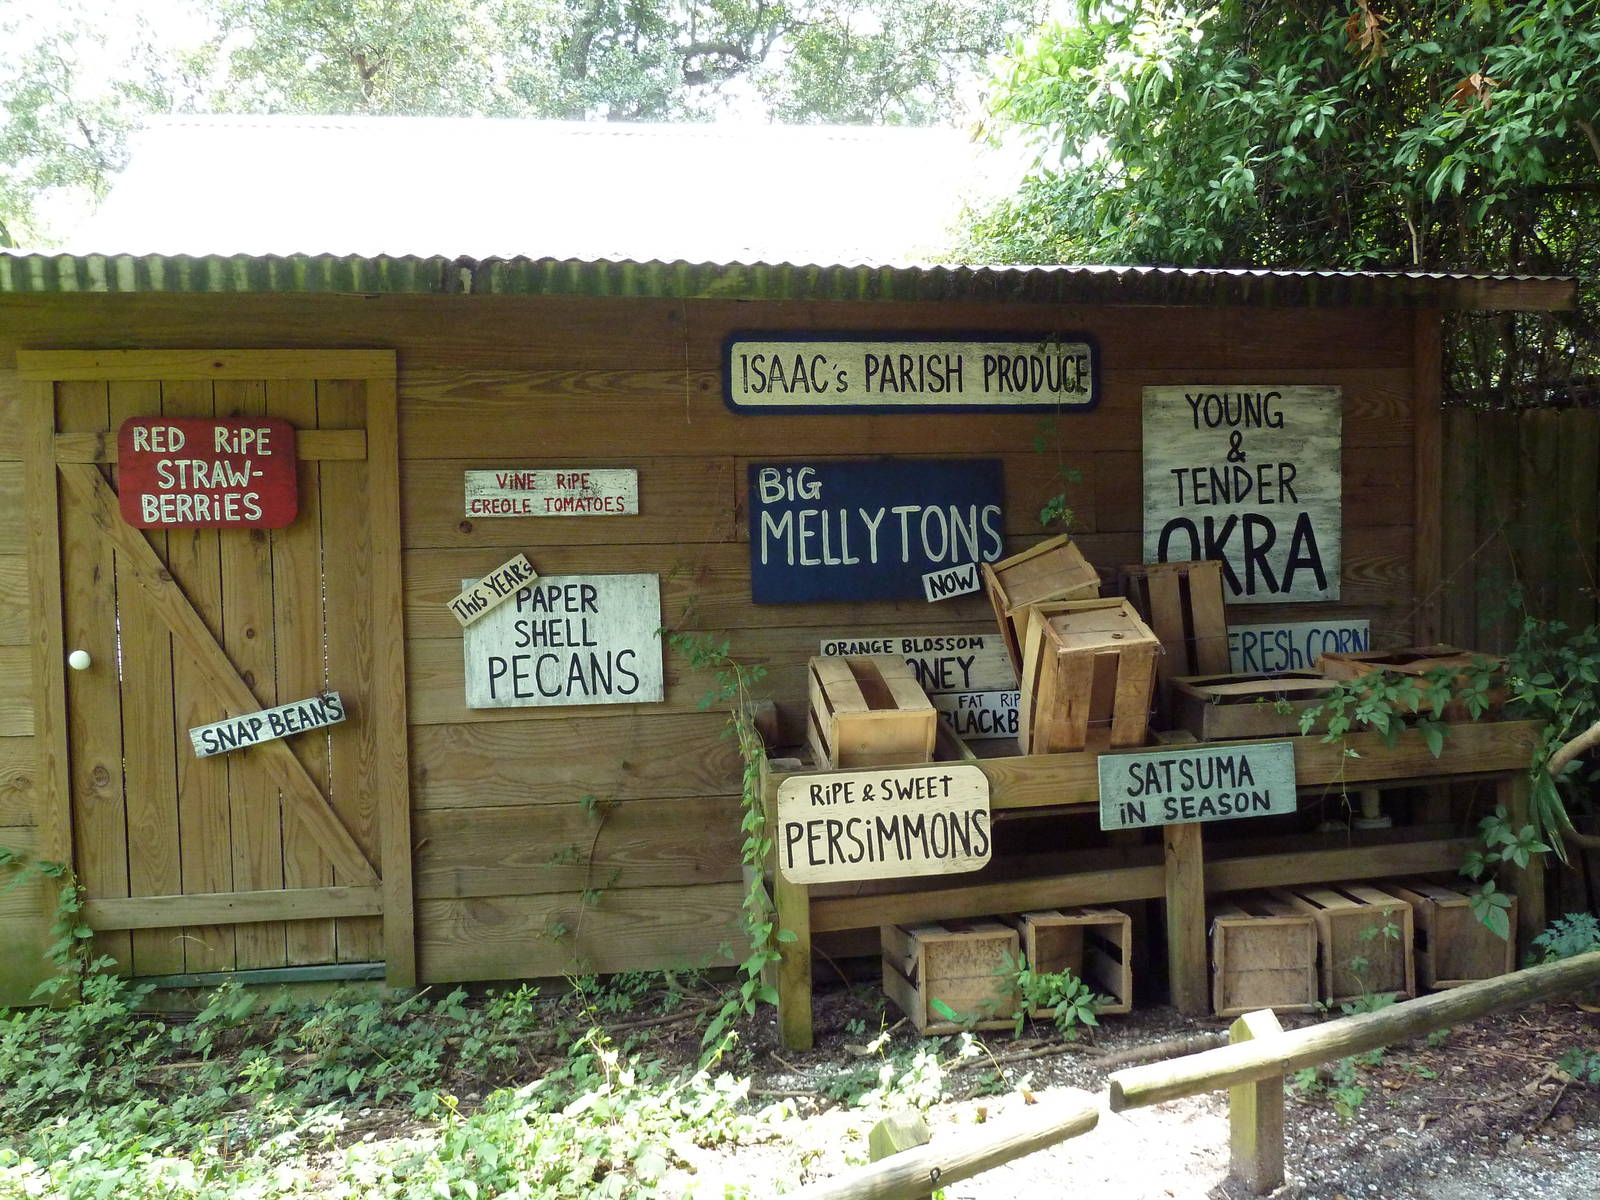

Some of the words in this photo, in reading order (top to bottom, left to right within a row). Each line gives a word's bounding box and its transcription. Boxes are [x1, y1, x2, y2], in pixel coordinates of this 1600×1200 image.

[740, 354, 848, 394] ISAAC's
[865, 354, 963, 394] PARISH
[983, 354, 1089, 394] PRODUCE
[1185, 391, 1284, 430] YOUNG
[133, 426, 185, 453] RED
[215, 426, 271, 455] RiPE
[1226, 430, 1246, 463] &
[157, 459, 263, 490] STRAW-
[759, 467, 822, 504] BiG
[1170, 462, 1298, 506] TENDER
[142, 493, 262, 522] BERRiES
[471, 498, 531, 514] CREOLE
[544, 496, 625, 513] TOMATOES
[761, 504, 1003, 566] MELLYTONS
[1158, 512, 1328, 597] OKRA
[515, 584, 599, 614] PAPER
[928, 566, 974, 599] NOW
[514, 617, 598, 648] SHELL
[825, 639, 894, 656] ORANGE
[902, 636, 984, 653] BLOSSOM
[1307, 627, 1369, 668] CORN
[488, 649, 640, 699] PECANS
[905, 655, 975, 690] ONEY
[958, 694, 984, 708] FAT
[1000, 693, 1021, 707] RiP
[201, 717, 263, 754] SNAP
[268, 695, 344, 736] BEANS
[862, 784, 877, 802] &
[1126, 755, 1255, 798] SATSUMA
[1164, 789, 1271, 821] SEASON
[785, 809, 990, 869] PERSiMMONS
